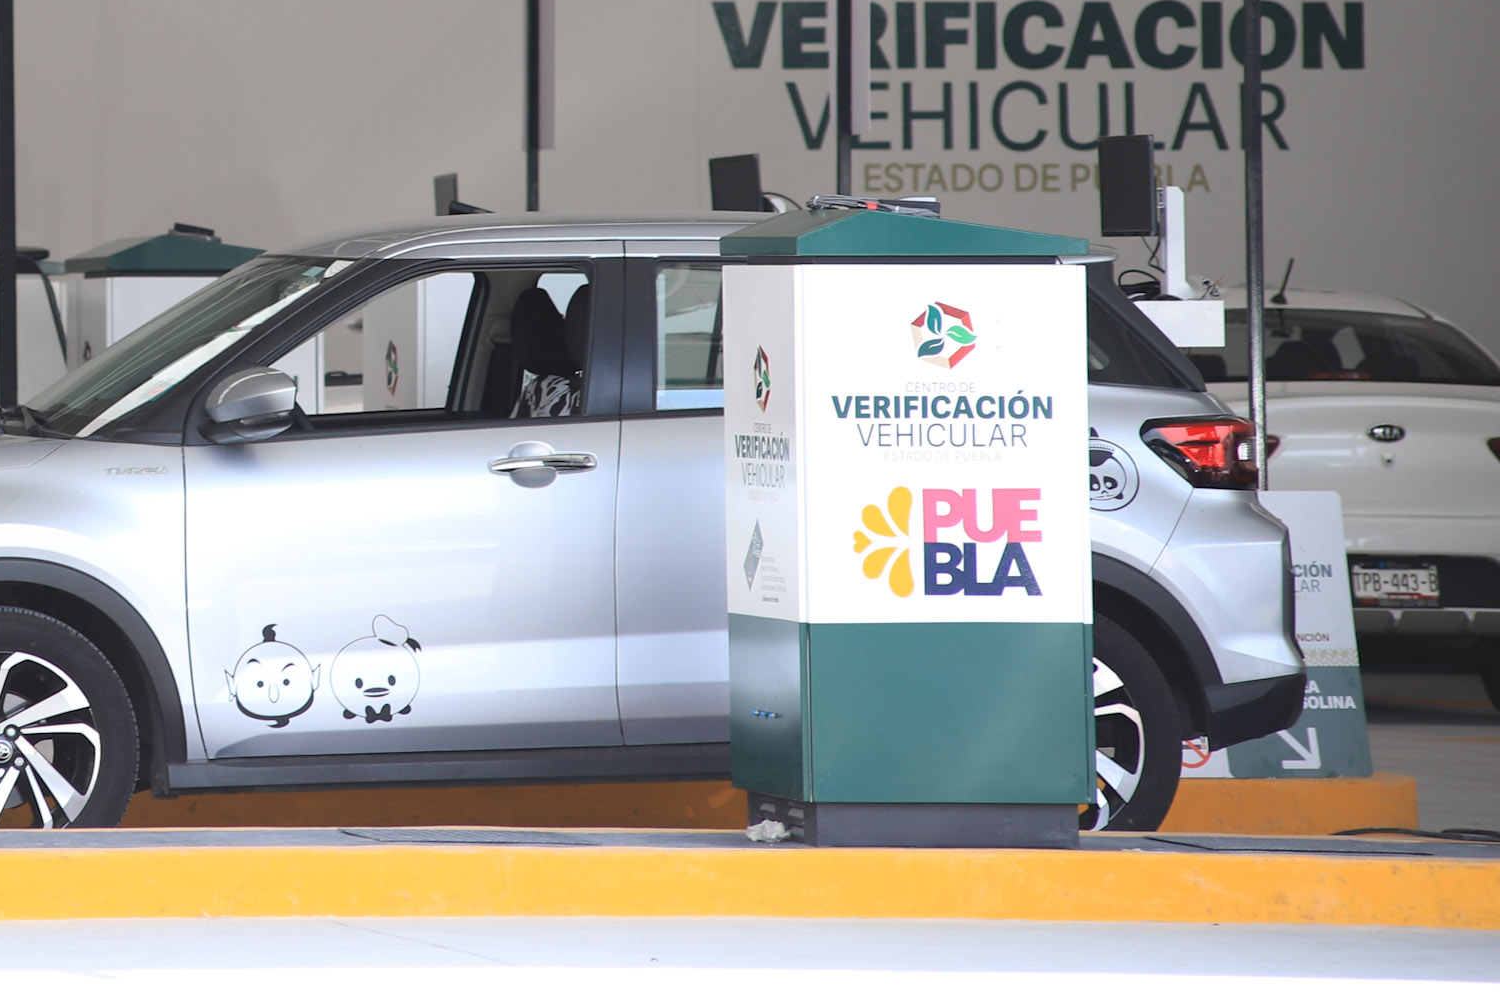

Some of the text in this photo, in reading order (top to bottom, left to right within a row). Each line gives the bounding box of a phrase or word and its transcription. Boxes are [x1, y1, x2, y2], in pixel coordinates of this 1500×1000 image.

[864, 163, 1003, 192] ESTADO
[1014, 163, 1061, 192] DE
[905, 382, 976, 393] CENTRO DE
[832, 390, 1053, 420] VERIFICACIÓN
[735, 432, 790, 461] VERIFICACIÓN
[857, 423, 1028, 447] VEHICULAR
[884, 450, 1003, 461] ESTADO DE PUEBLA
[741, 462, 786, 488] VEHICULAR
[922, 488, 1042, 543] PUE
[924, 542, 1043, 596] BLA
[1353, 572, 1437, 592] TPB-443-B
